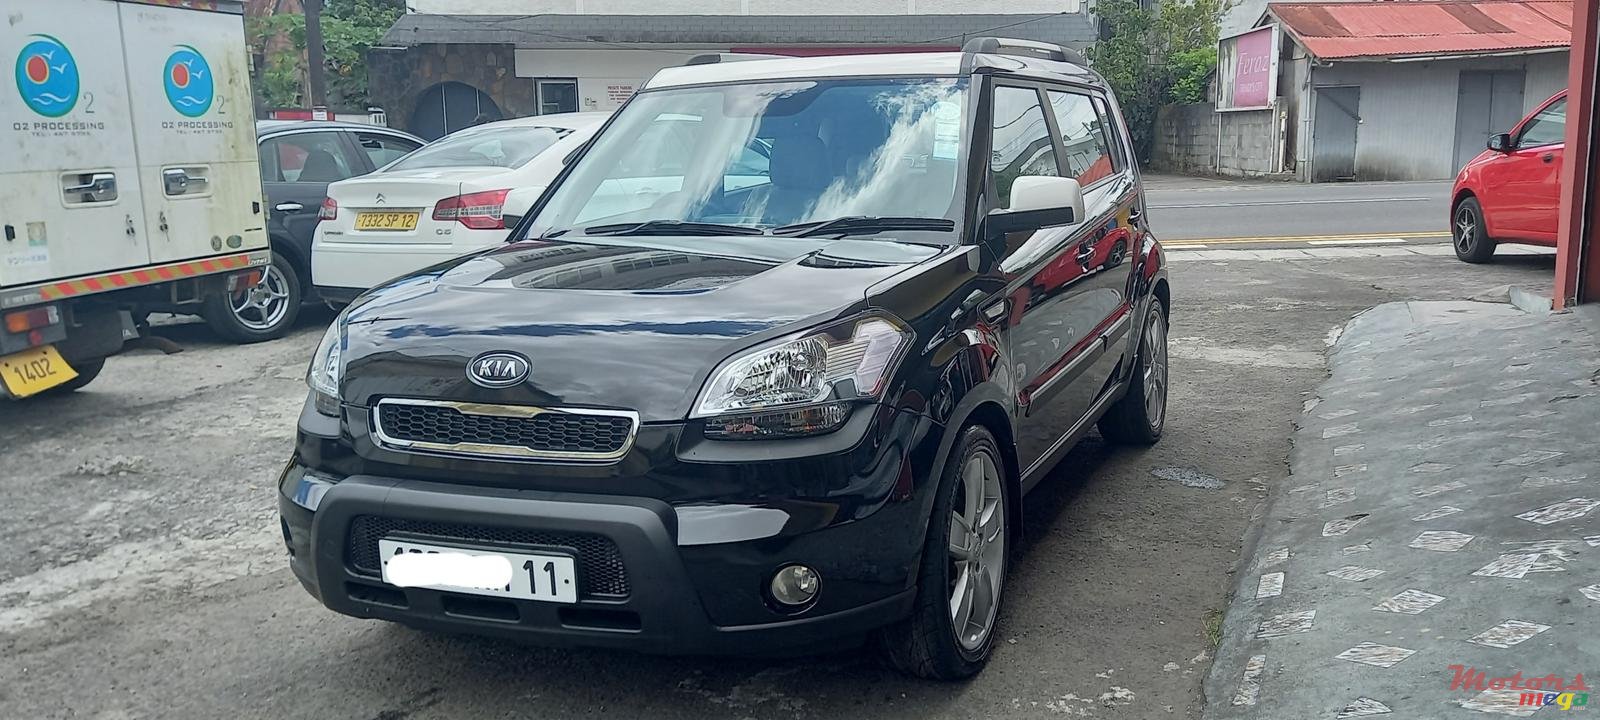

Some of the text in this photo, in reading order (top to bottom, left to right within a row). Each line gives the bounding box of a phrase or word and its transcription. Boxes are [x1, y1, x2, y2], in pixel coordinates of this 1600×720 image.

[83, 91, 95, 114] 2
[216, 95, 226, 115] 2
[34, 121, 105, 130] PROCESSING
[177, 121, 234, 129] PROCESSING
[360, 213, 413, 228] 7332 SP 12
[435, 228, 452, 236] C5
[14, 357, 57, 386] 1402
[478, 360, 517, 377] KIA
[522, 560, 557, 596] 11
